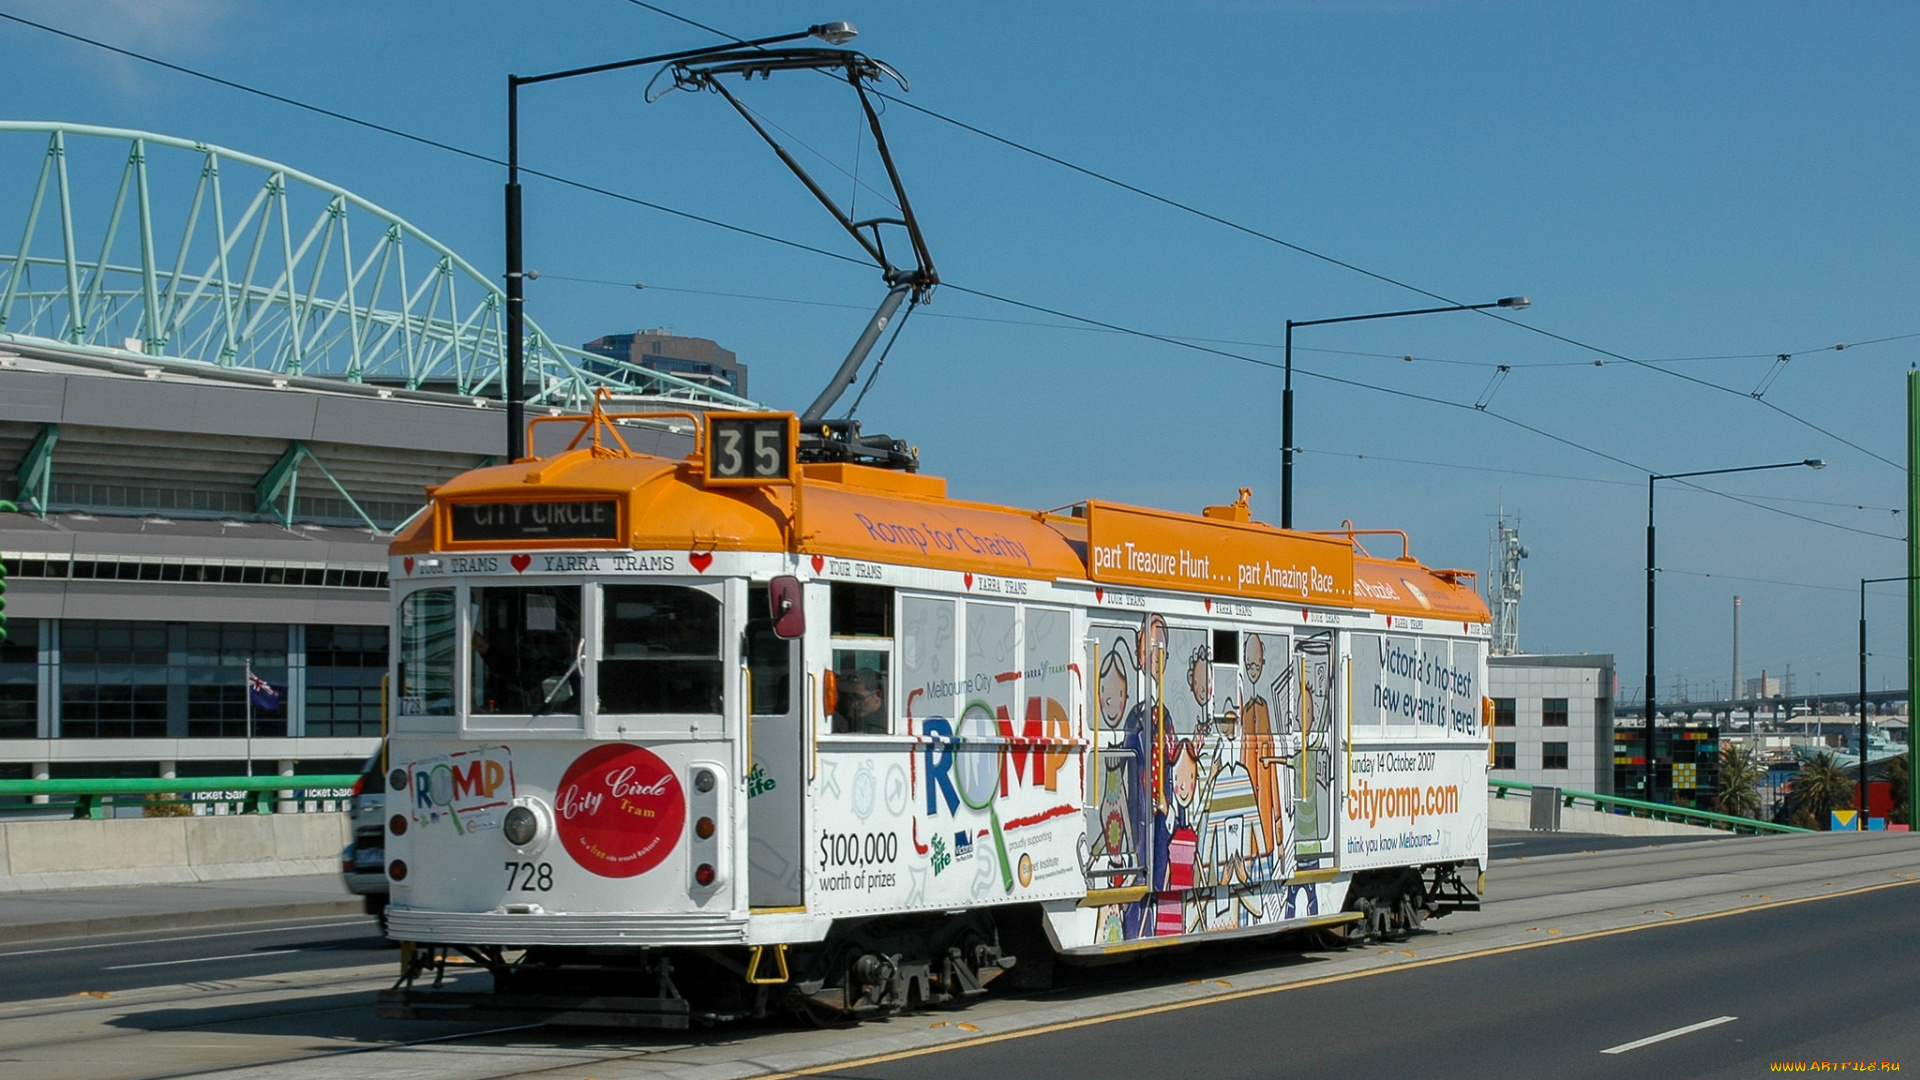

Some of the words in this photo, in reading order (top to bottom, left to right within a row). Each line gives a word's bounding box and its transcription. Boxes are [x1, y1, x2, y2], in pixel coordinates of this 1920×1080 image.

[718, 430, 779, 475] 35
[474, 503, 523, 525] CITY
[532, 502, 605, 524] CIRCLE
[855, 513, 928, 556] Romp
[921, 522, 960, 551] for
[956, 527, 1032, 567] Charity
[450, 557, 498, 573] TRAMS
[544, 556, 600, 572] YARRA
[613, 555, 675, 571] TRAMS
[829, 560, 851, 577] YOUR
[855, 563, 882, 580] TRAMS
[1094, 543, 1121, 574] part
[1125, 542, 1176, 576] Treasure
[1179, 549, 1209, 579] Hunt
[1238, 561, 1260, 590] part
[1263, 560, 1308, 597] Amazing
[1311, 565, 1333, 593] Race
[978, 577, 1001, 593] YARRA
[1004, 580, 1028, 595] TRAMS
[1358, 578, 1401, 600] Puzzle!
[1378, 636, 1431, 686] Victoria's
[926, 679, 974, 700] Melbourne
[975, 673, 992, 695] City
[1373, 683, 1400, 713] new
[1403, 693, 1434, 725] event
[1437, 696, 1446, 729] is
[1450, 698, 1476, 736] here!
[1351, 753, 1374, 778] unday
[1377, 753, 1385, 772] 14
[1386, 752, 1417, 773] October
[1417, 752, 1436, 771] 2007
[554, 784, 604, 819] City
[605, 766, 674, 798] Circle
[1347, 778, 1458, 828] cityromp.com
[620, 798, 655, 818] Tram
[820, 828, 898, 872] $100,000
[1347, 835, 1364, 854] think
[1365, 841, 1378, 857] you
[1379, 833, 1398, 852] know
[504, 861, 553, 892] 728
[819, 870, 851, 892] worth
[854, 869, 866, 890] of
[868, 869, 896, 894] prizes
